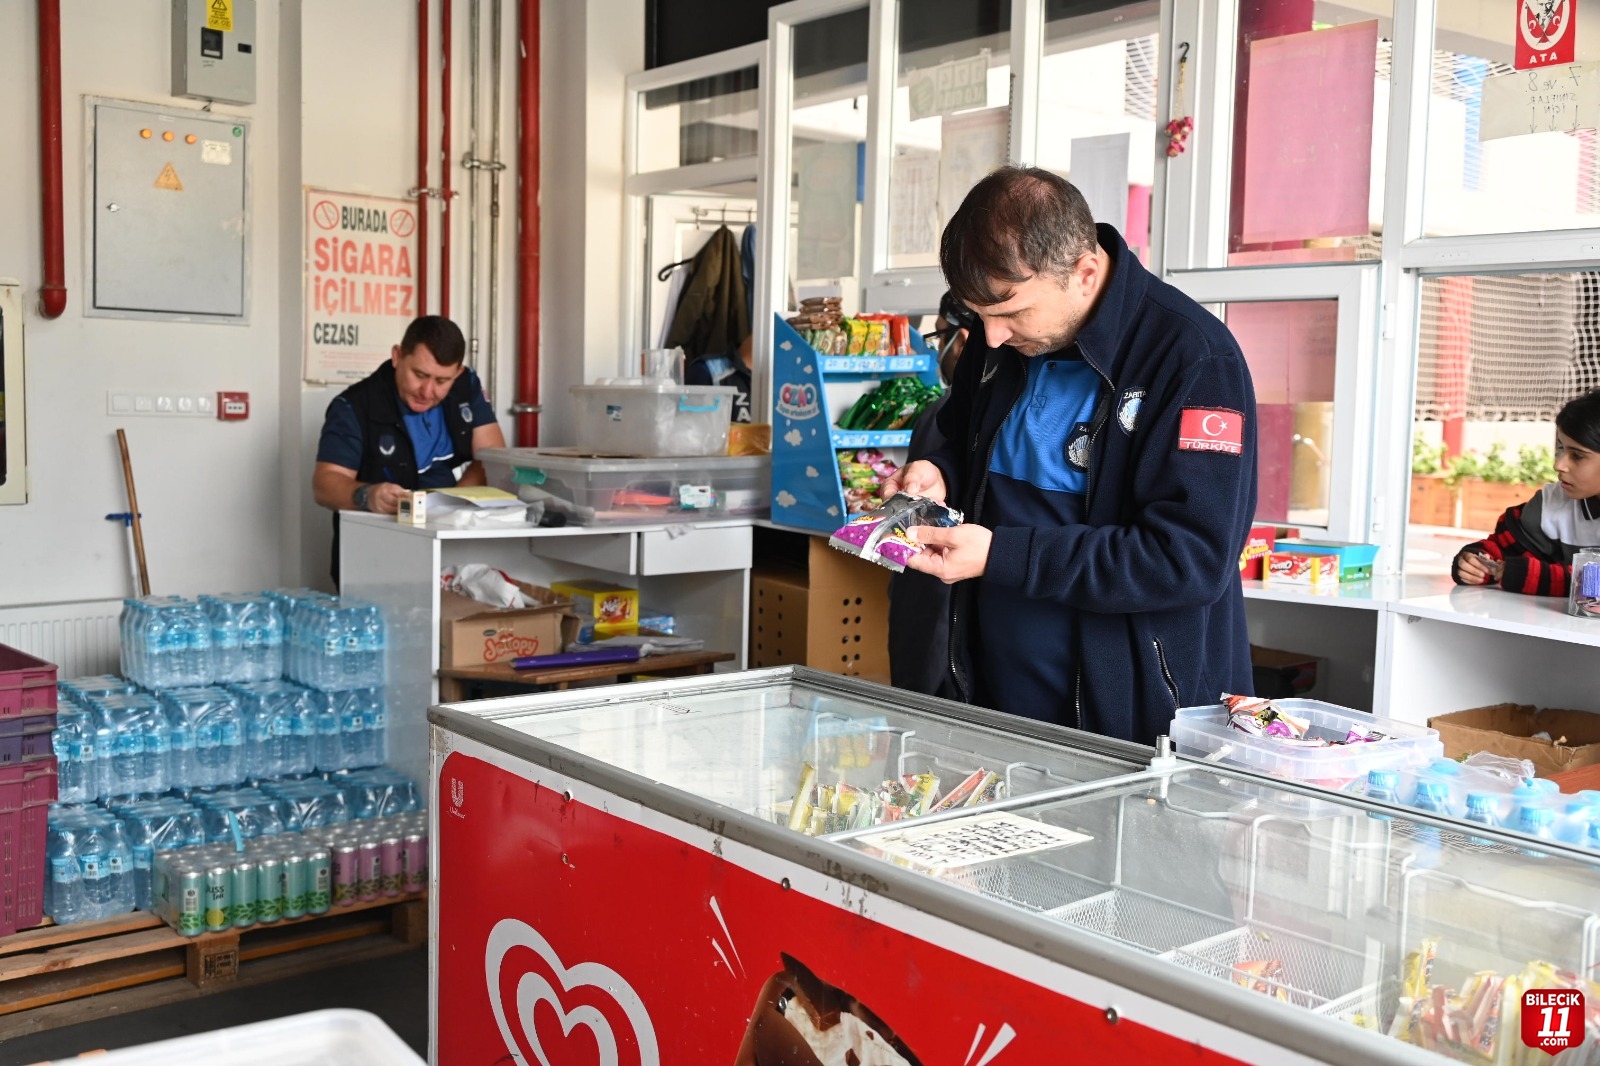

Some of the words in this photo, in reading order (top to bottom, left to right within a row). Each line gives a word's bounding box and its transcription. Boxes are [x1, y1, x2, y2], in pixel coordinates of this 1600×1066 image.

[1529, 52, 1558, 64] ATA
[341, 206, 388, 233] BURADA
[313, 322, 359, 346] CEZASI
[1184, 439, 1238, 454] TÜRKİYE
